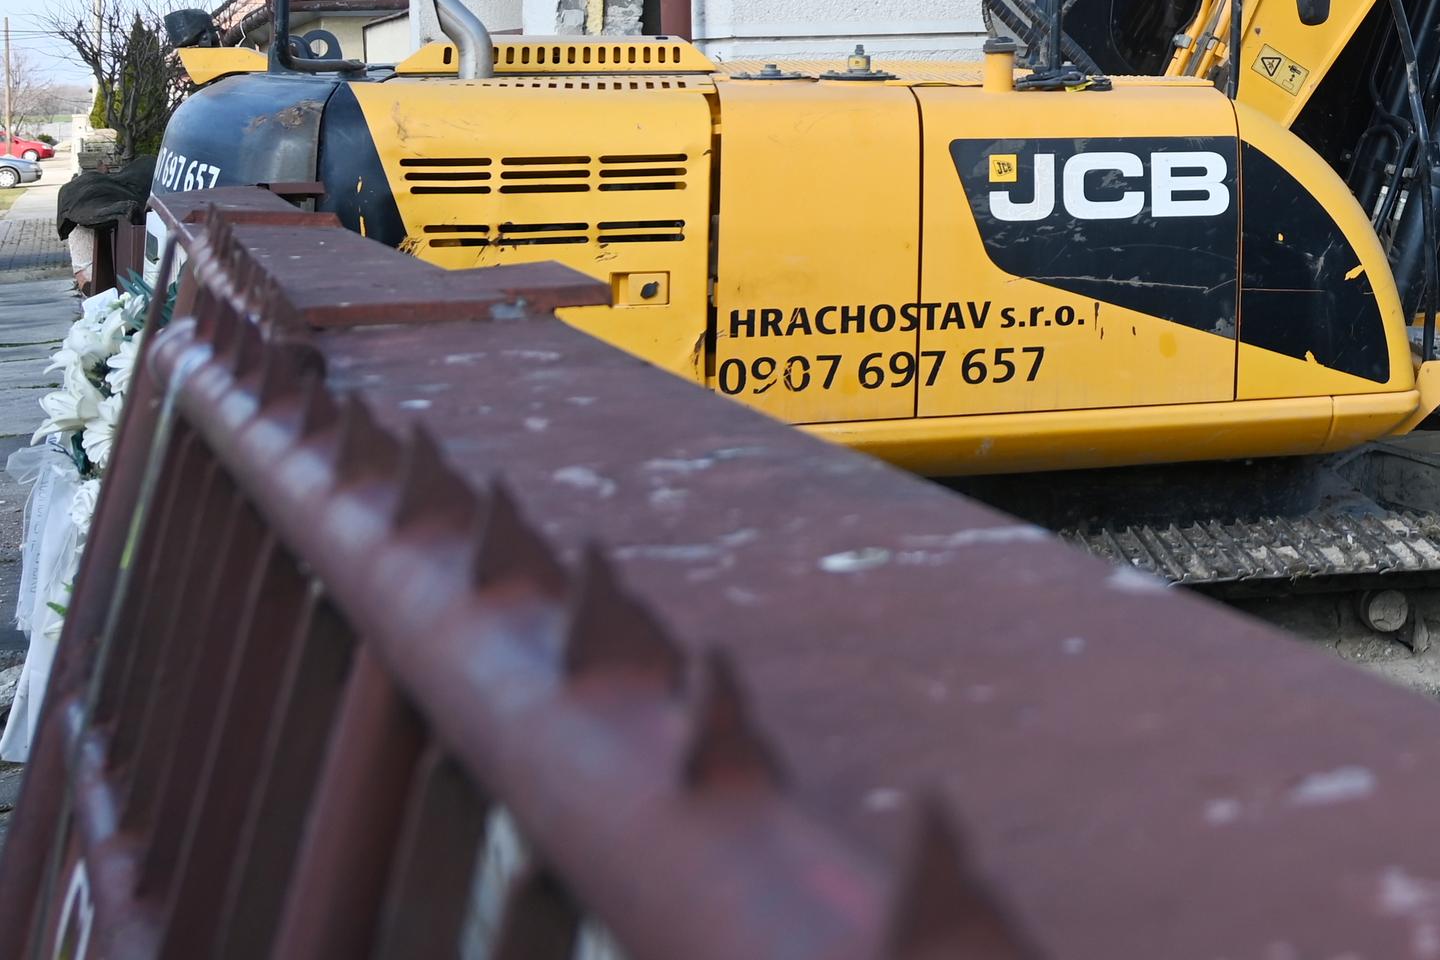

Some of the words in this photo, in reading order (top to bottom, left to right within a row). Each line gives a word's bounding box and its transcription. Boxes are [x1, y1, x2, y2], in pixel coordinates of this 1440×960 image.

[162, 151, 187, 191] 697
[184, 160, 221, 191] 657
[989, 152, 1229, 221] JCB
[729, 301, 991, 338] HRACHOSTAV
[1000, 305, 1085, 328] s.r.o.
[718, 354, 842, 396] 0907
[858, 350, 946, 389] 697
[961, 346, 1045, 385] 657
